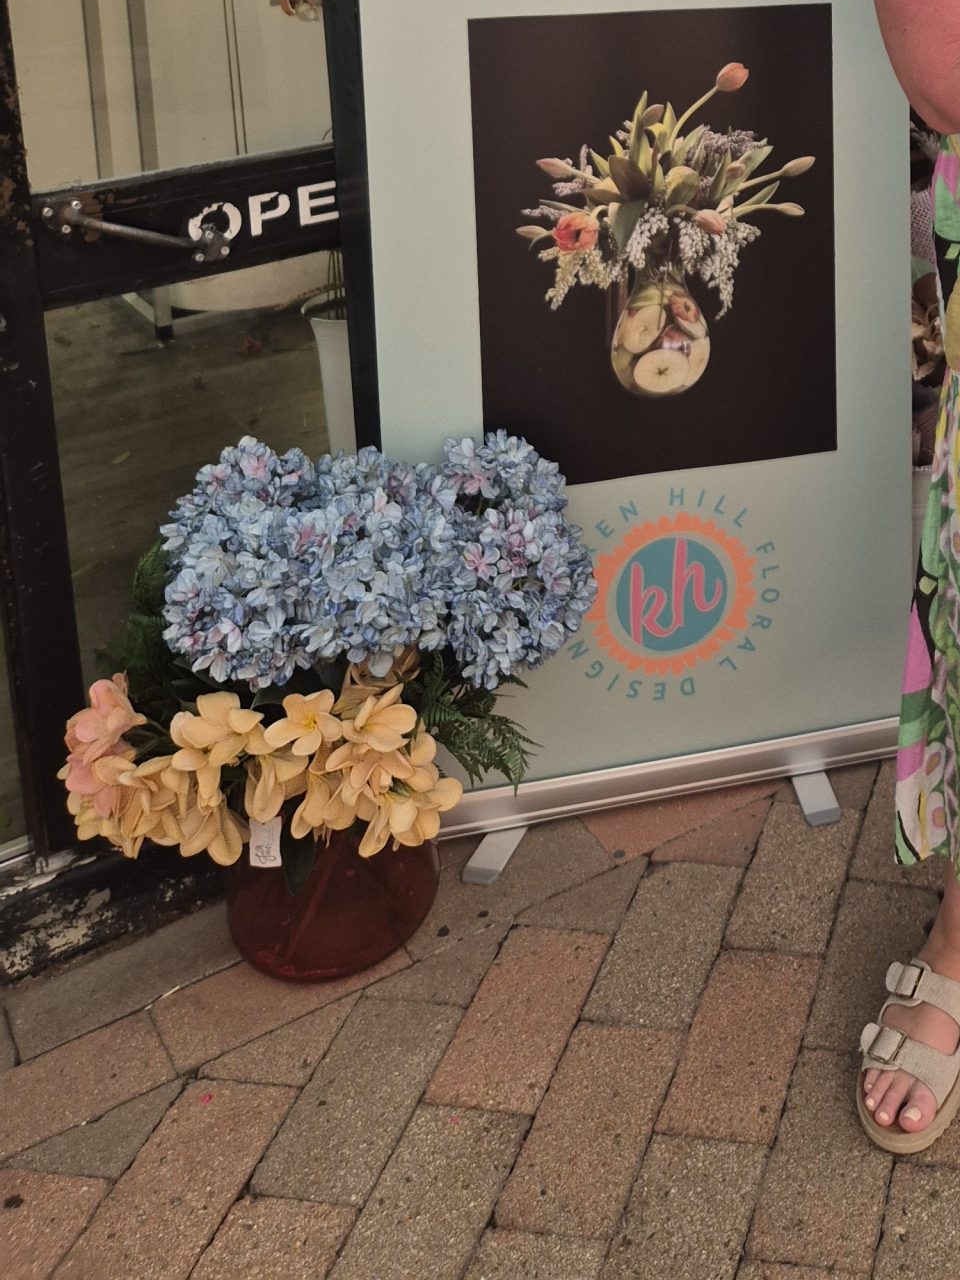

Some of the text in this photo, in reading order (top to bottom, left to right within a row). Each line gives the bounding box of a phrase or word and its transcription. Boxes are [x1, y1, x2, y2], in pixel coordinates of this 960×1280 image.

[669, 487, 748, 528] HILL
[629, 536, 723, 646] kh
[719, 541, 780, 671] FLORAL
[567, 639, 696, 701] DESIGN
